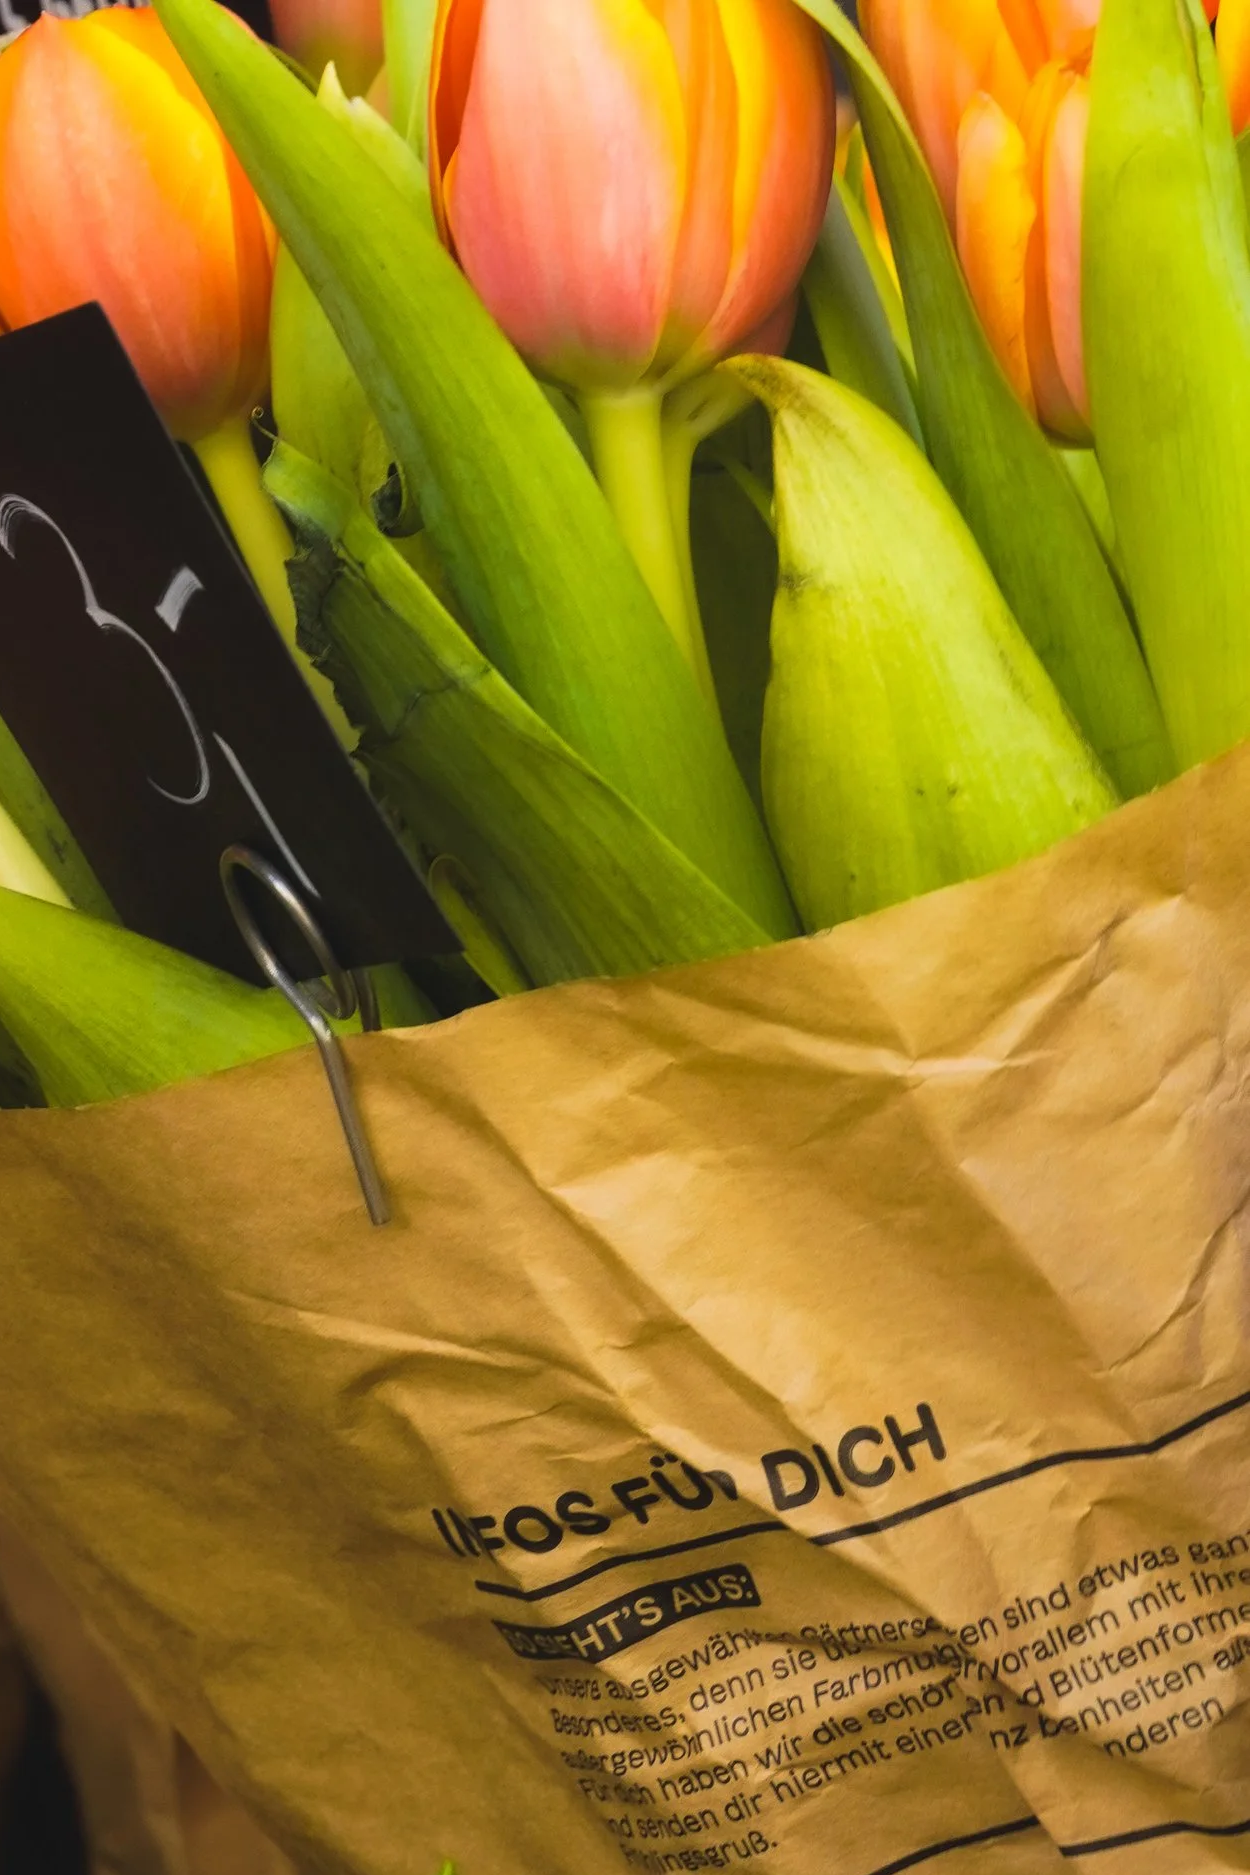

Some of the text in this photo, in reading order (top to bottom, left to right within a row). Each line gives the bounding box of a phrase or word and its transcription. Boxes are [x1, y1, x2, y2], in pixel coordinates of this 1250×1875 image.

[761, 1402, 947, 1511] DICH
[671, 1573, 754, 1614] AUS:
[1003, 1582, 1071, 1630] sind
[1078, 1545, 1180, 1598] etwas
[1187, 1529, 1250, 1564] gan
[689, 1666, 765, 1712] denn
[772, 1648, 817, 1680] sie
[1128, 1578, 1186, 1621] mit
[636, 1807, 719, 1838] senden
[724, 1792, 762, 1823] dir
[770, 1739, 893, 1803] hiermit
[657, 1758, 749, 1801] haben
[754, 1733, 802, 1770] wir
[813, 1716, 862, 1746] die
